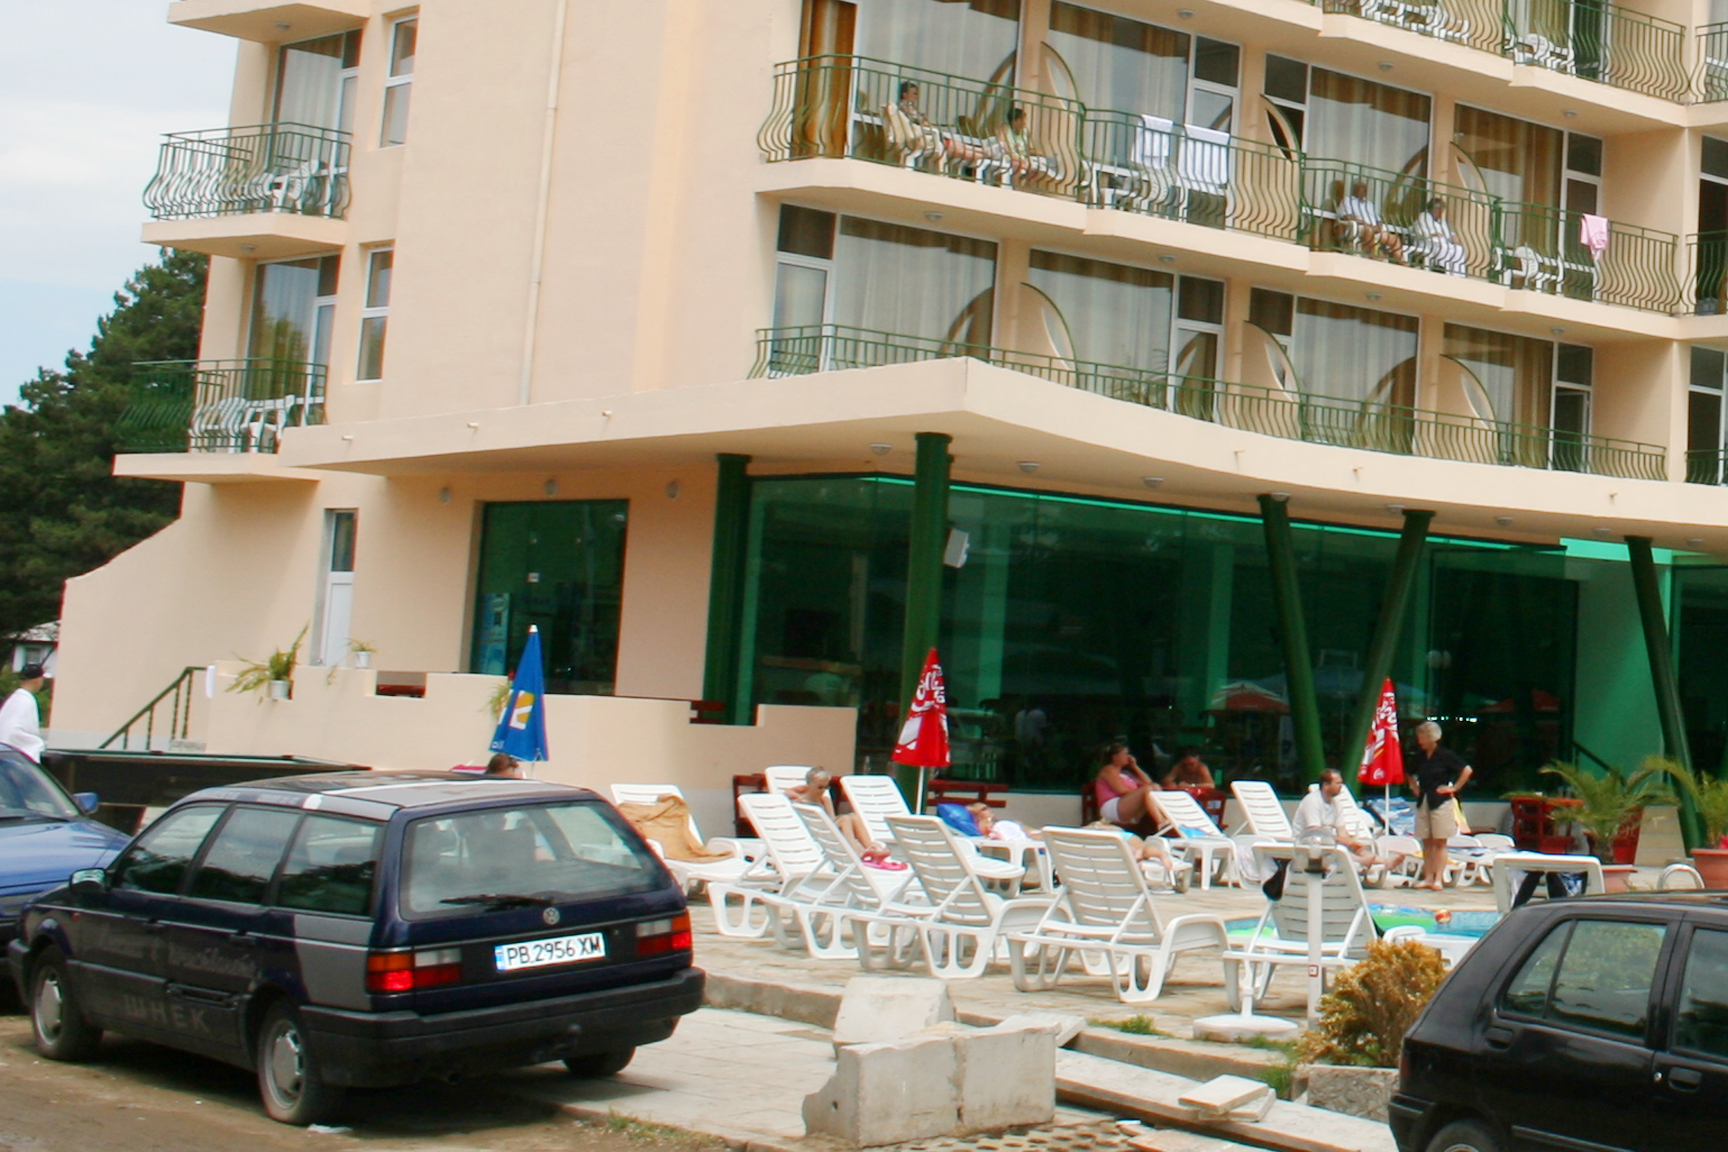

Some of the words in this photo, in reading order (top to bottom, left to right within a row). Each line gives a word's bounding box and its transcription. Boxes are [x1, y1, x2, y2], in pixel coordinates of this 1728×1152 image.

[506, 947, 530, 965] PB
[533, 939, 576, 962] 2956
[124, 995, 211, 1033] ШНЕК
